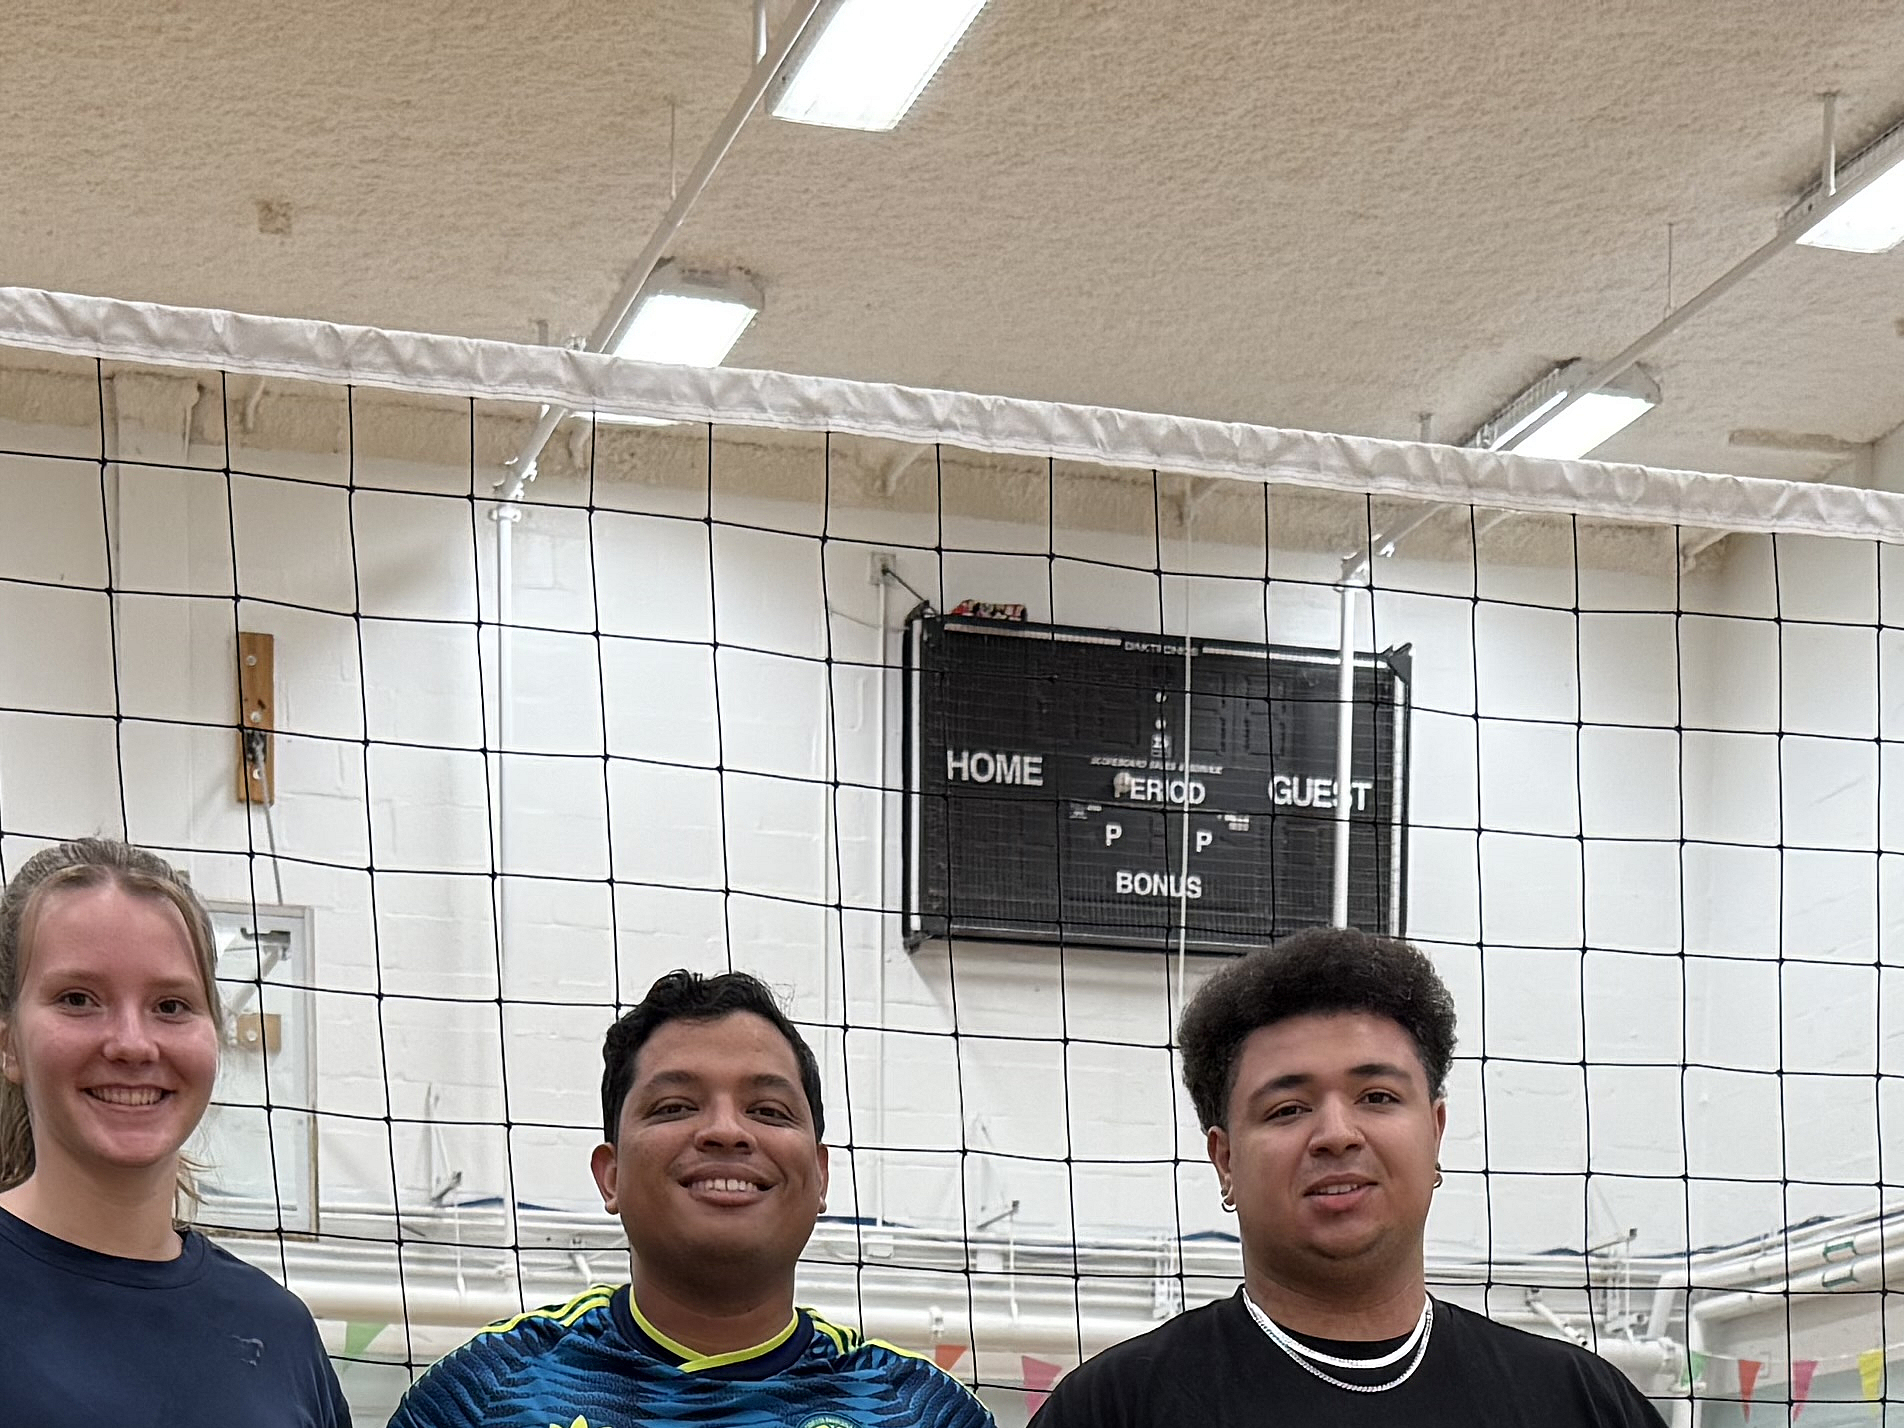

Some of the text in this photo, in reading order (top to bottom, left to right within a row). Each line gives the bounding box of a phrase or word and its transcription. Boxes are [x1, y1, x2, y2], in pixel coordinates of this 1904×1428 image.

[946, 749, 1044, 787] HOME
[1105, 822, 1123, 847] P
[1196, 830, 1214, 853] P
[1116, 870, 1203, 899] BONUS
